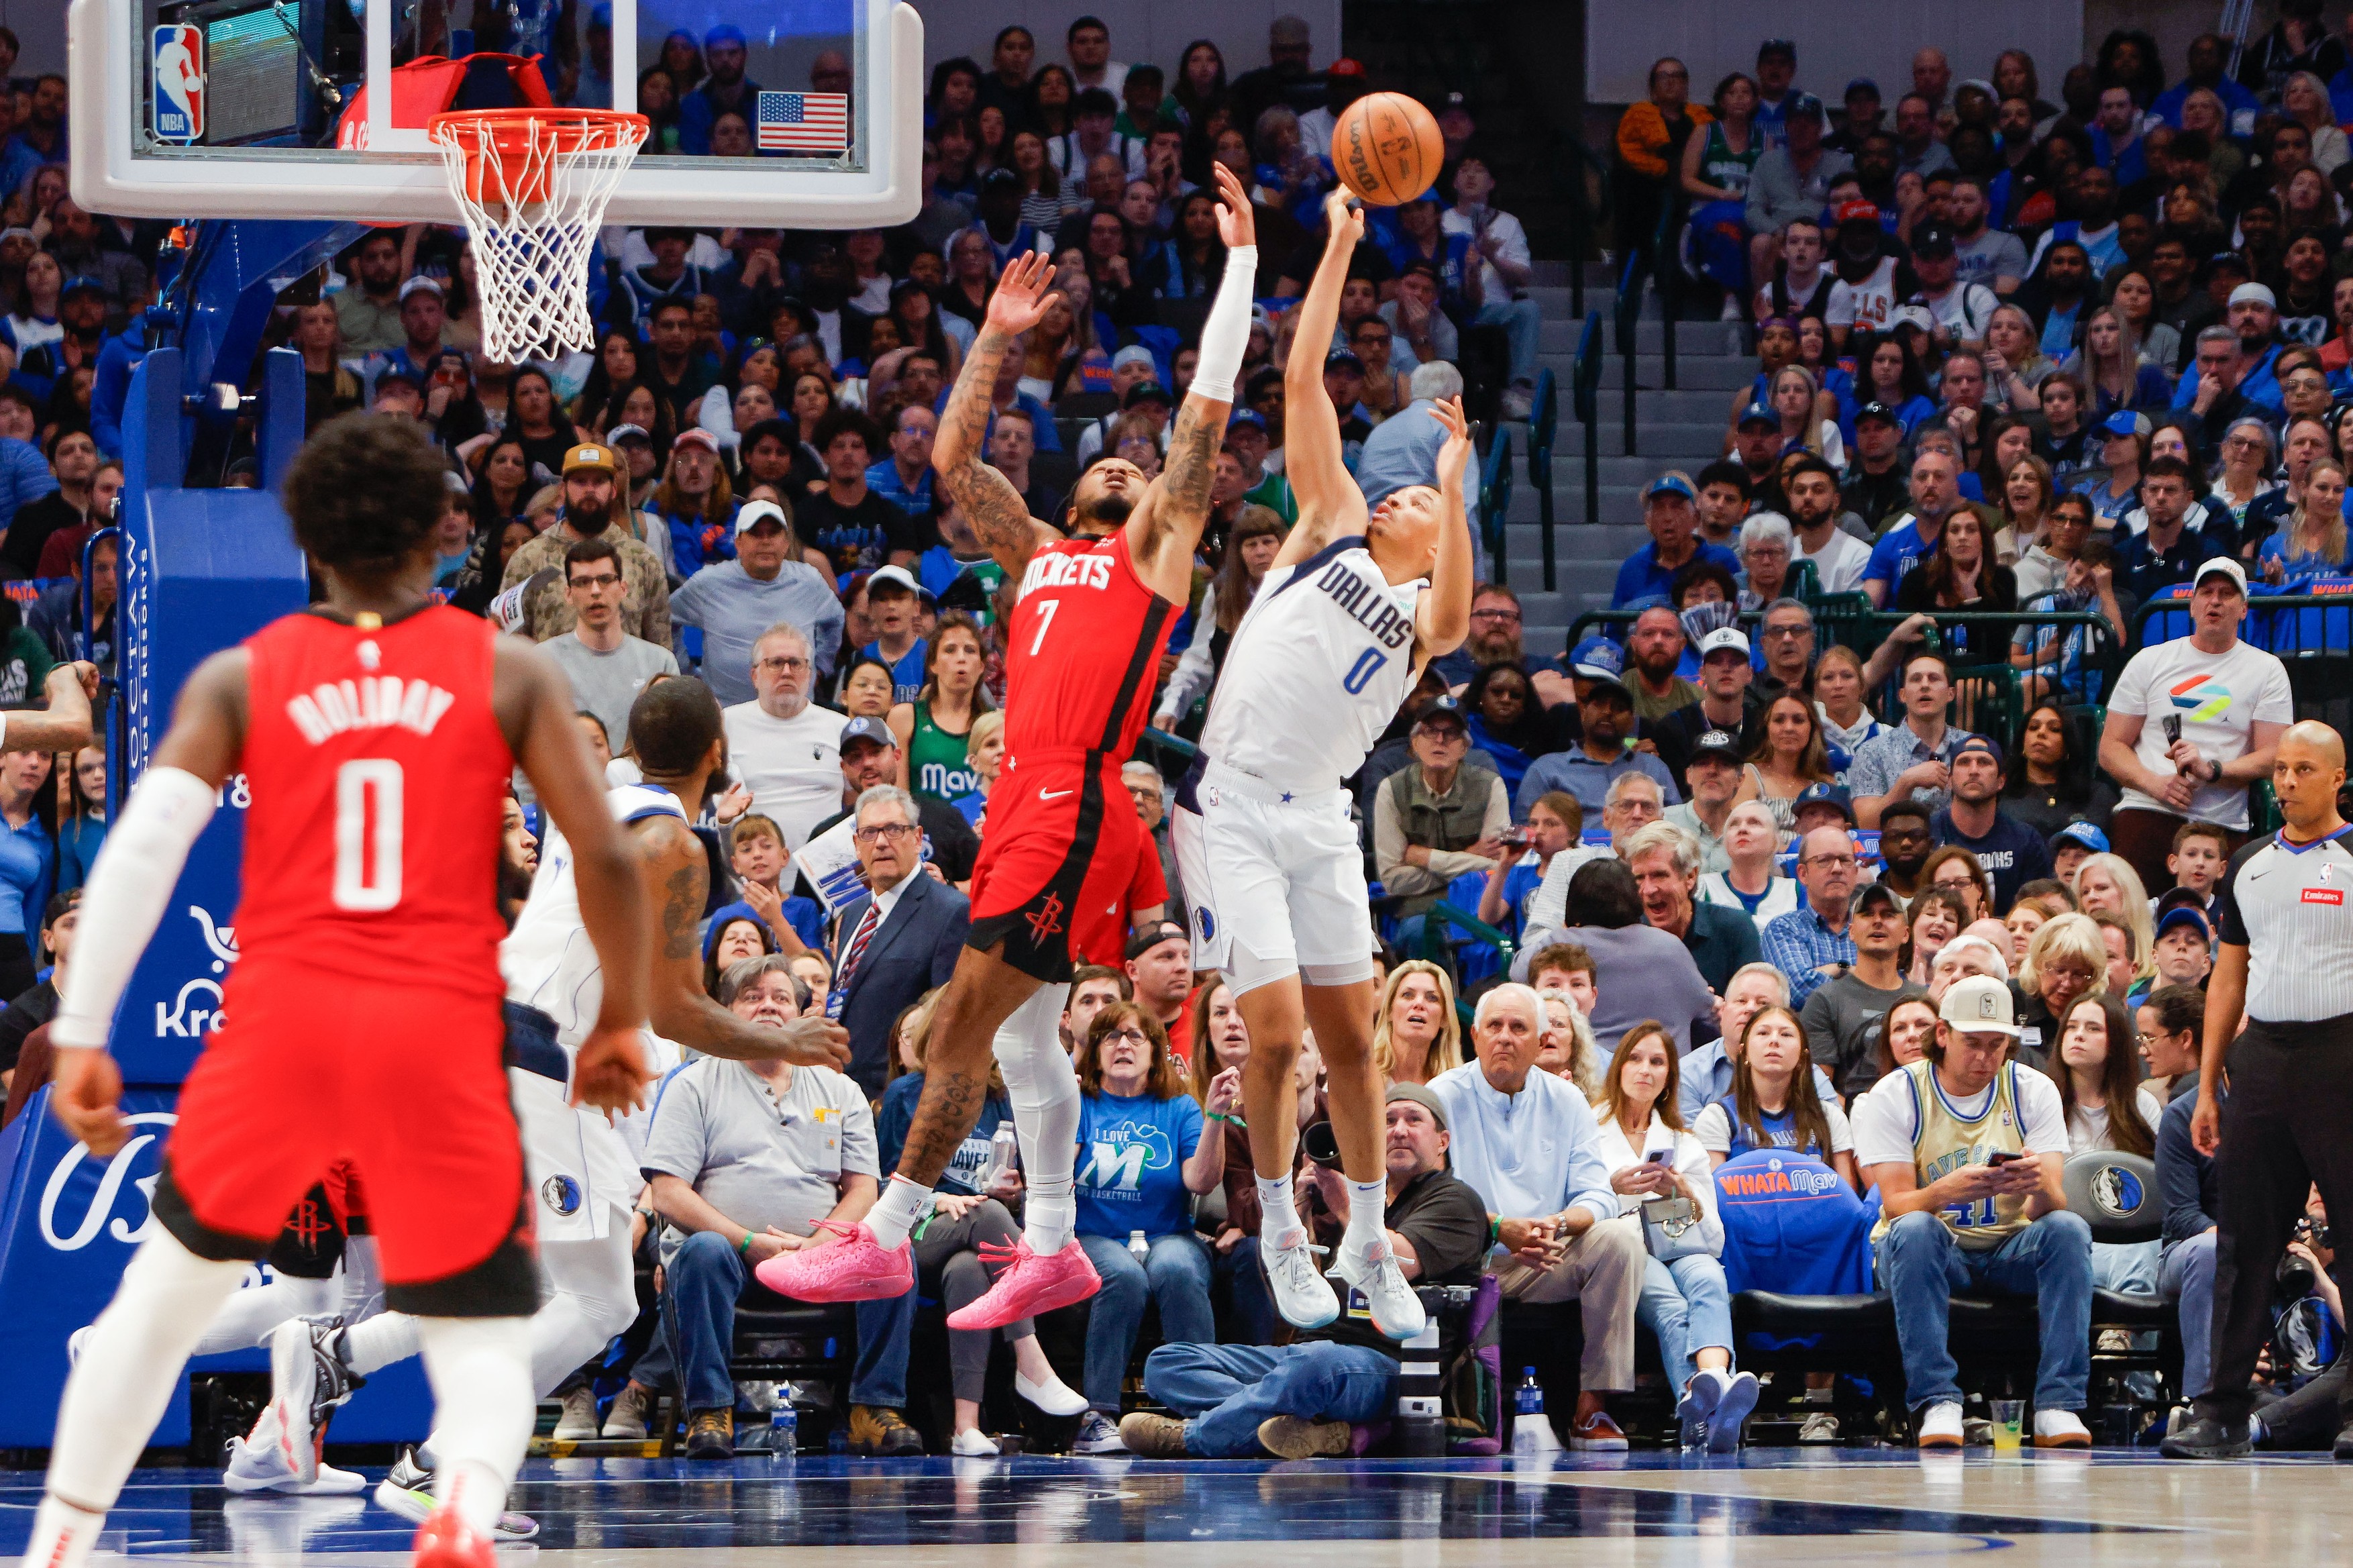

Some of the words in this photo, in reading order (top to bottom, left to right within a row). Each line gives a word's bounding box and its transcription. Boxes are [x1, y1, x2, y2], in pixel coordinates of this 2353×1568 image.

[161, 113, 185, 131] NBA
[1316, 560, 1413, 649] DALLAS
[1030, 599, 1059, 656] 7
[1344, 646, 1389, 695] 0
[331, 757, 405, 913] 0
[2304, 890, 2340, 902] Emirates
[1095, 1128, 1100, 1139] I
[1103, 1130, 1131, 1142] LOVE
[1090, 1188, 1142, 1202] BASKETBALL
